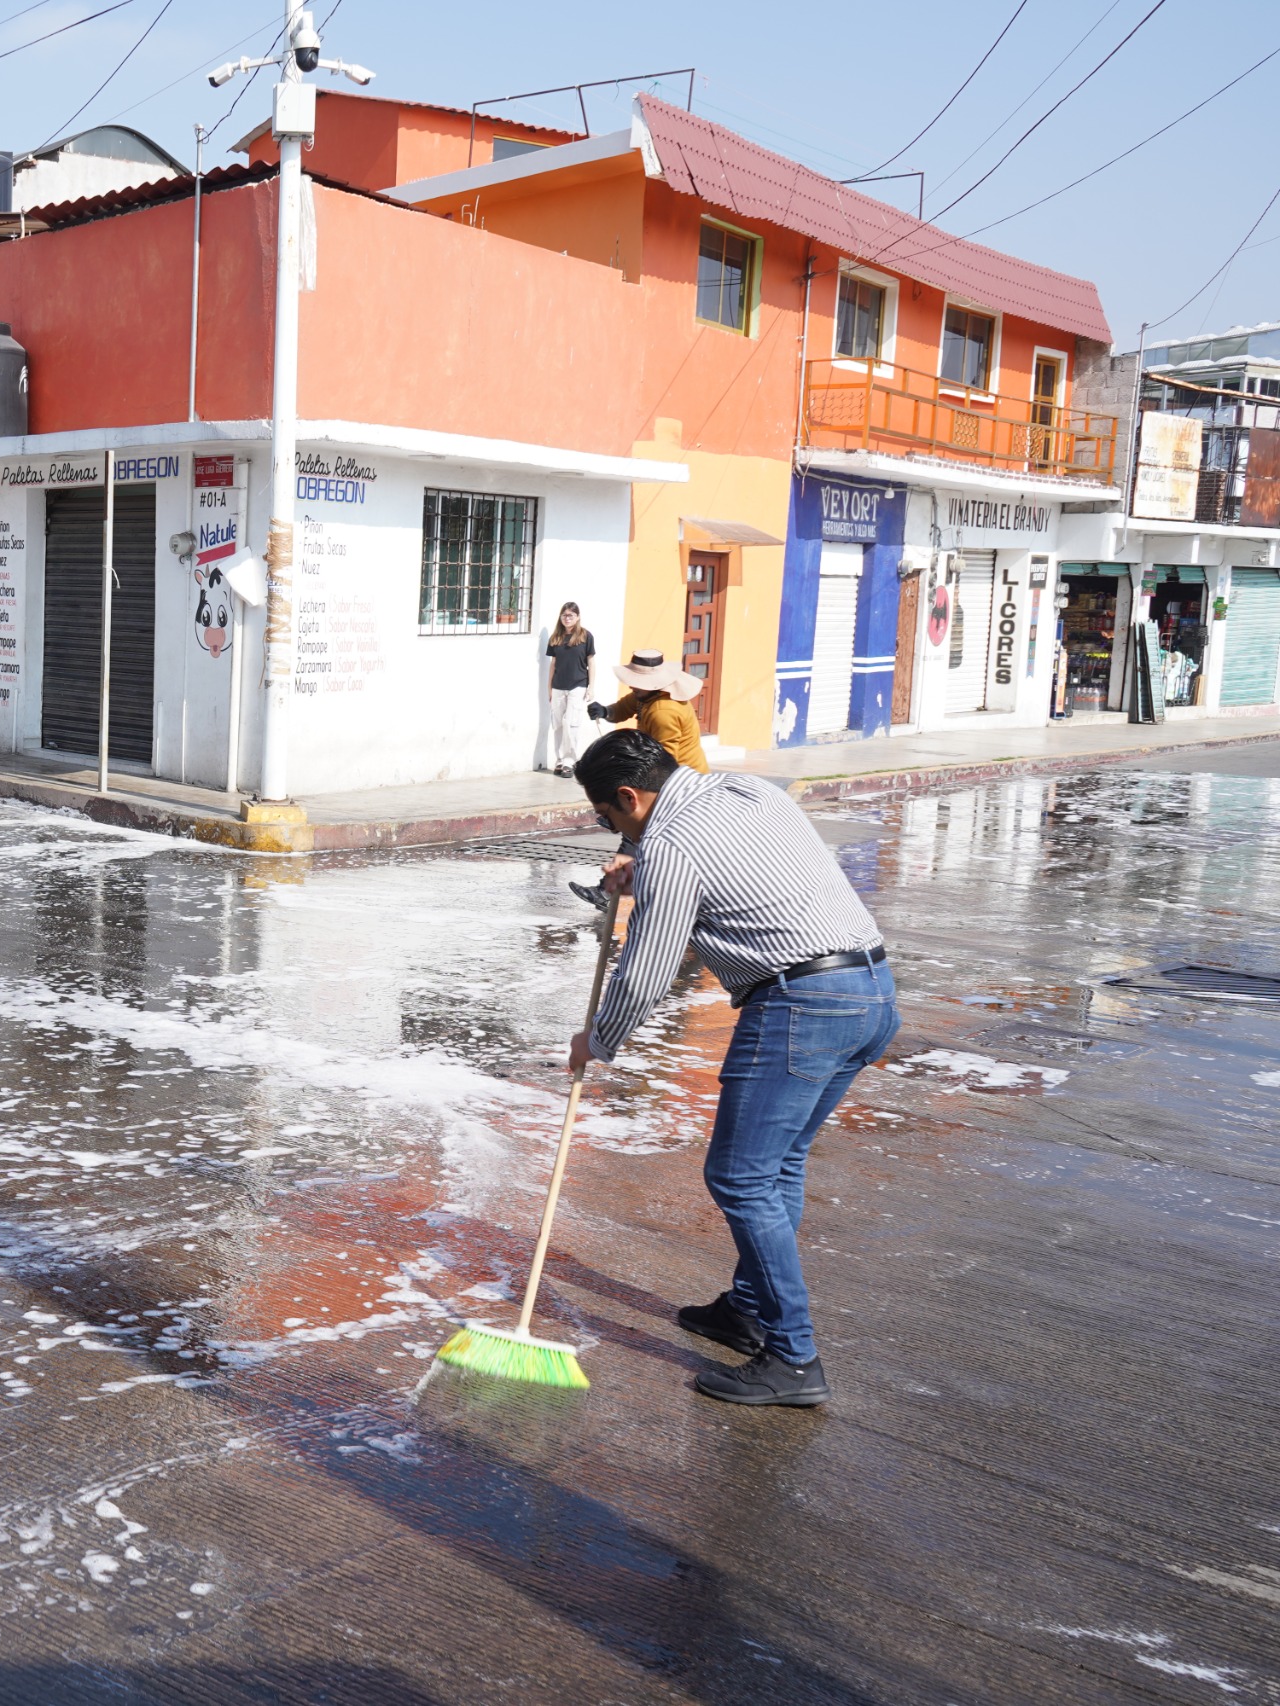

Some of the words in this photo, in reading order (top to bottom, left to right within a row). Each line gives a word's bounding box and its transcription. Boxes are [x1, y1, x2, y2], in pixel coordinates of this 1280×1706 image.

[1, 466, 45, 486] Paletas
[48, 463, 98, 483] Rellenas
[295, 452, 331, 476] Paletas
[333, 456, 377, 481] Rellenas
[200, 491, 227, 508] #01-A
[296, 476, 365, 504] OBREGON
[821, 485, 880, 522] VEYORT
[304, 514, 323, 534] Piñon
[948, 498, 998, 529] VINATERIA
[998, 503, 1011, 530] EL
[1013, 505, 1052, 533] BRANDY
[10, 534, 24, 550] Secas
[303, 536, 324, 555] Frutas
[327, 535, 347, 556] Secas
[302, 558, 320, 575] Nuez
[299, 596, 325, 614] Lechera
[298, 615, 320, 636] Cajeta
[995, 568, 1019, 685] LICORES
[297, 635, 328, 655] Rompope
[295, 656, 332, 674] Zarzamora
[294, 676, 318, 697] Mango
